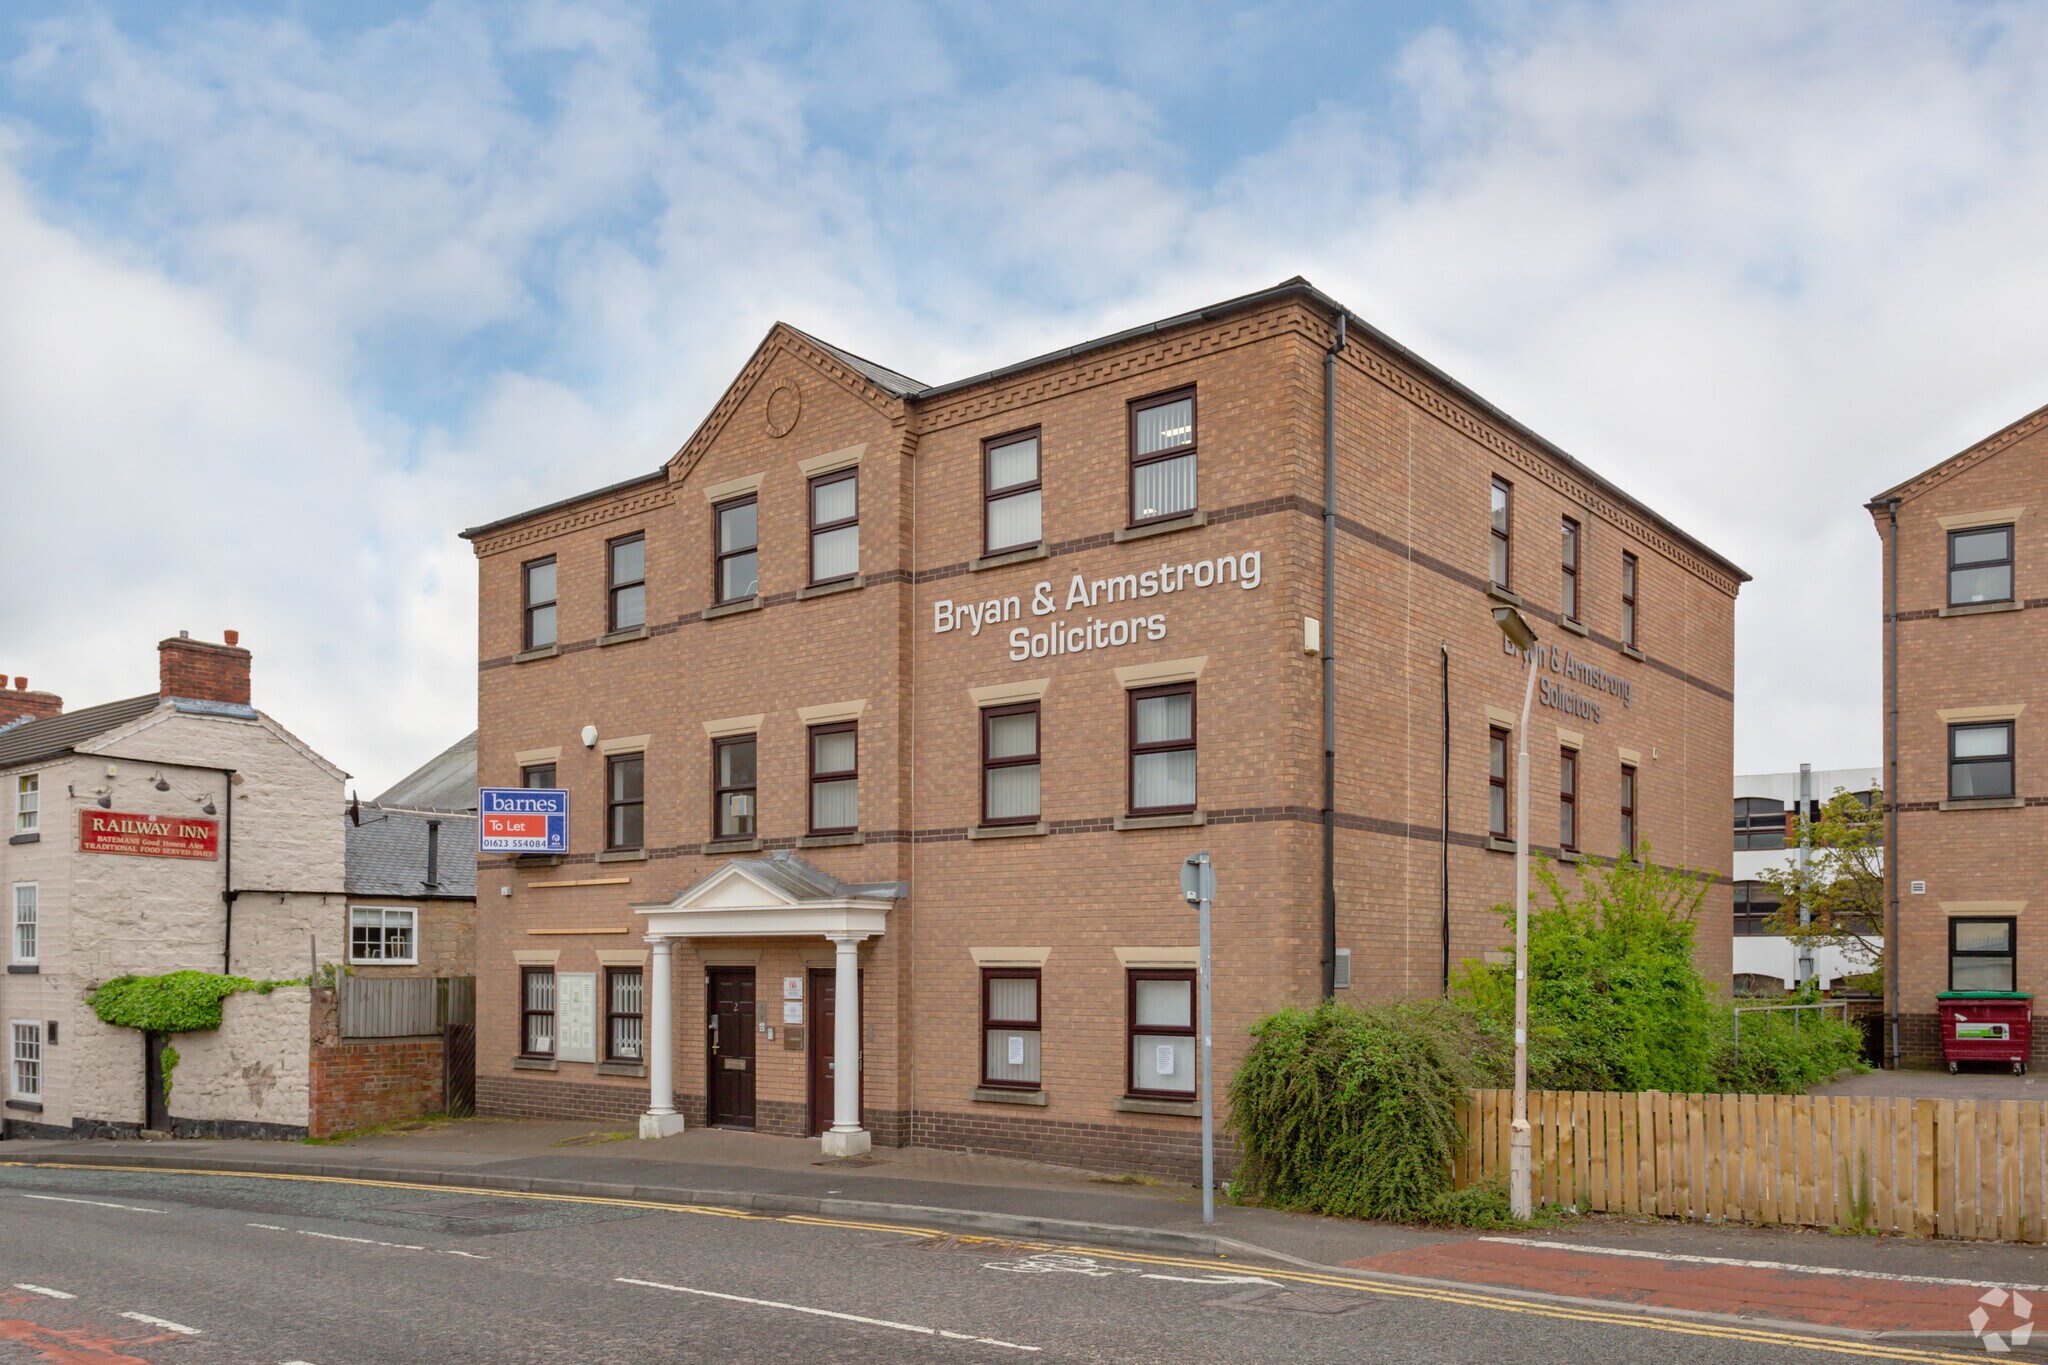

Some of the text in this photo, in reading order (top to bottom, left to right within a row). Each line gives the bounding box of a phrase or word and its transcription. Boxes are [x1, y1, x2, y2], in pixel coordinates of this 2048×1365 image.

[934, 550, 1262, 637] Bryan & Armstrong
[1009, 613, 1167, 662] Solicitors
[1550, 643, 1562, 673] &
[1565, 650, 1632, 708] Armstrong
[1540, 675, 1601, 723] Solicitors
[491, 793, 557, 812] barnes
[92, 818, 209, 839] RAILWAY INN
[489, 820, 526, 832] To Let
[85, 842, 137, 852] TRADITIONAL
[97, 836, 140, 845] BATEMANS
[484, 839, 509, 847] 01623
[512, 840, 546, 848] 554084
[733, 1002, 739, 1012] 2
